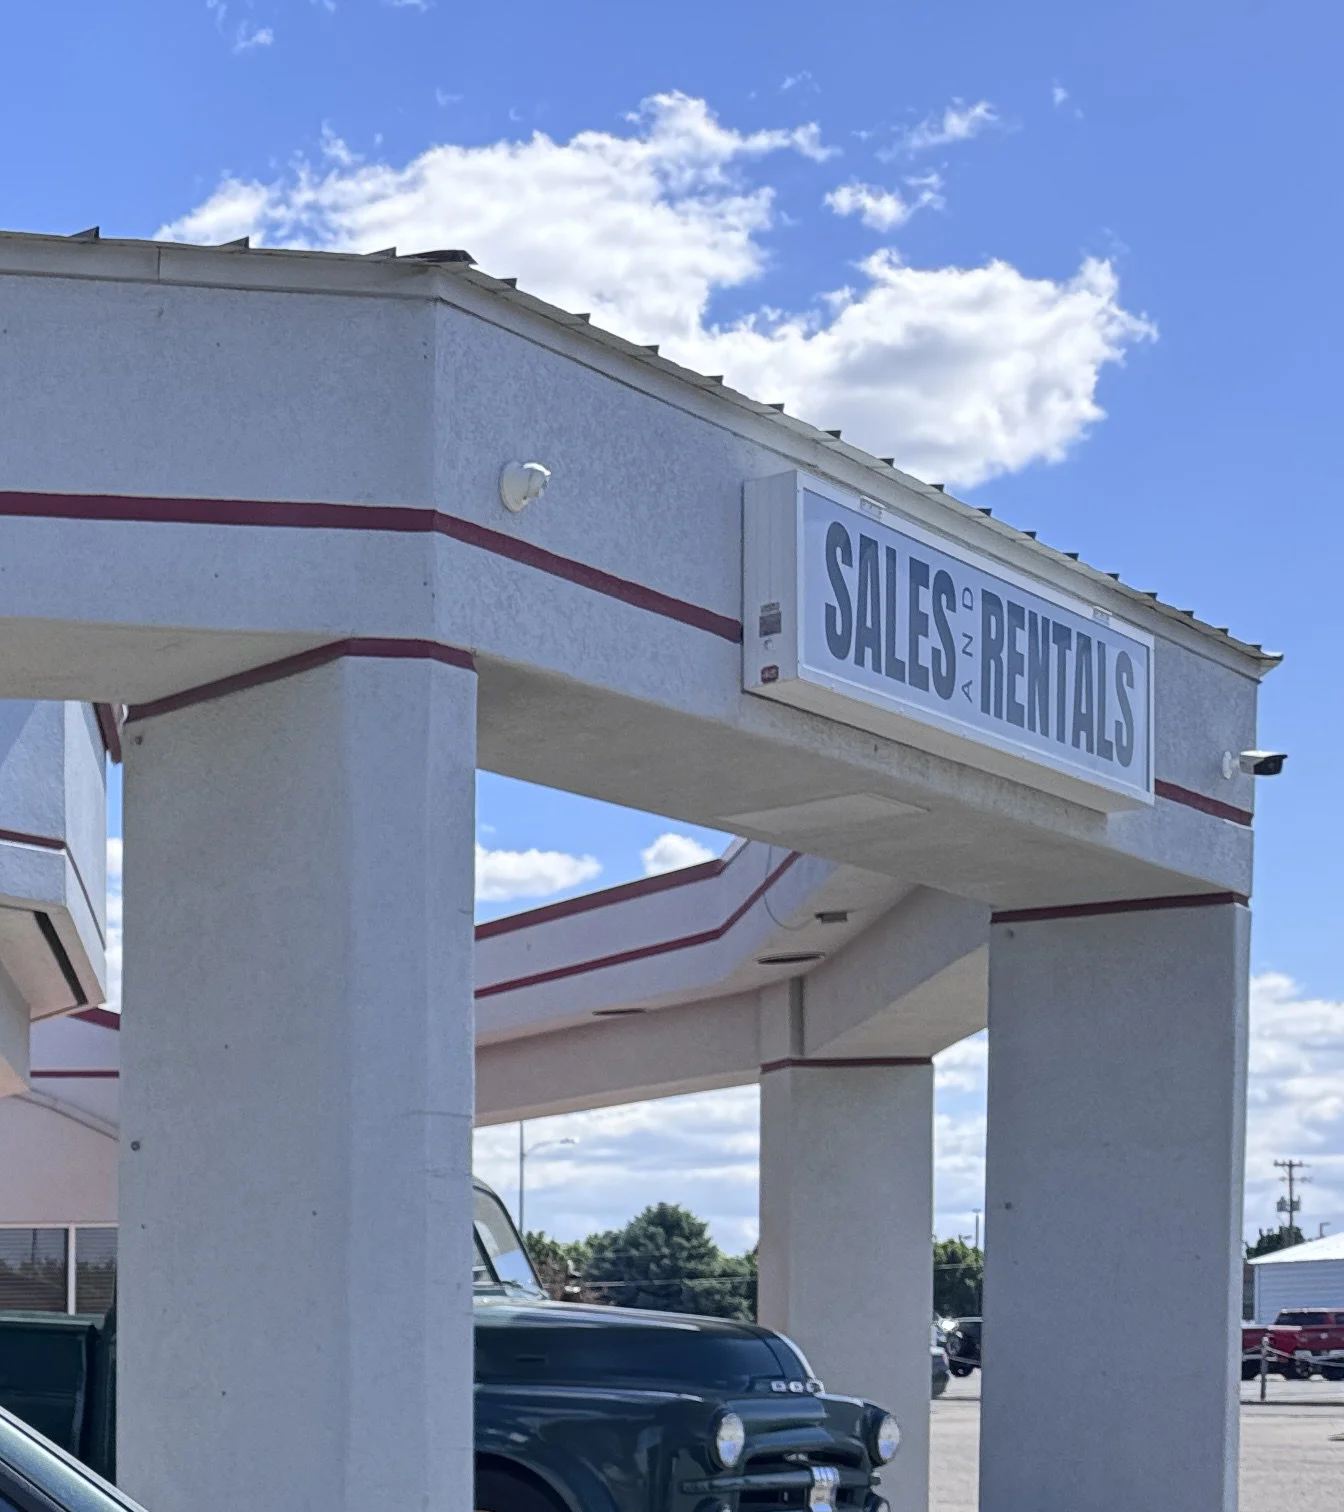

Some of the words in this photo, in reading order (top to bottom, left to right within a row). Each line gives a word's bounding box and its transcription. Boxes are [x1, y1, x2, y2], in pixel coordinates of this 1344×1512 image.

[825, 521, 956, 700] SALES
[961, 586, 974, 704] AND
[981, 588, 1135, 768] RENTALS
